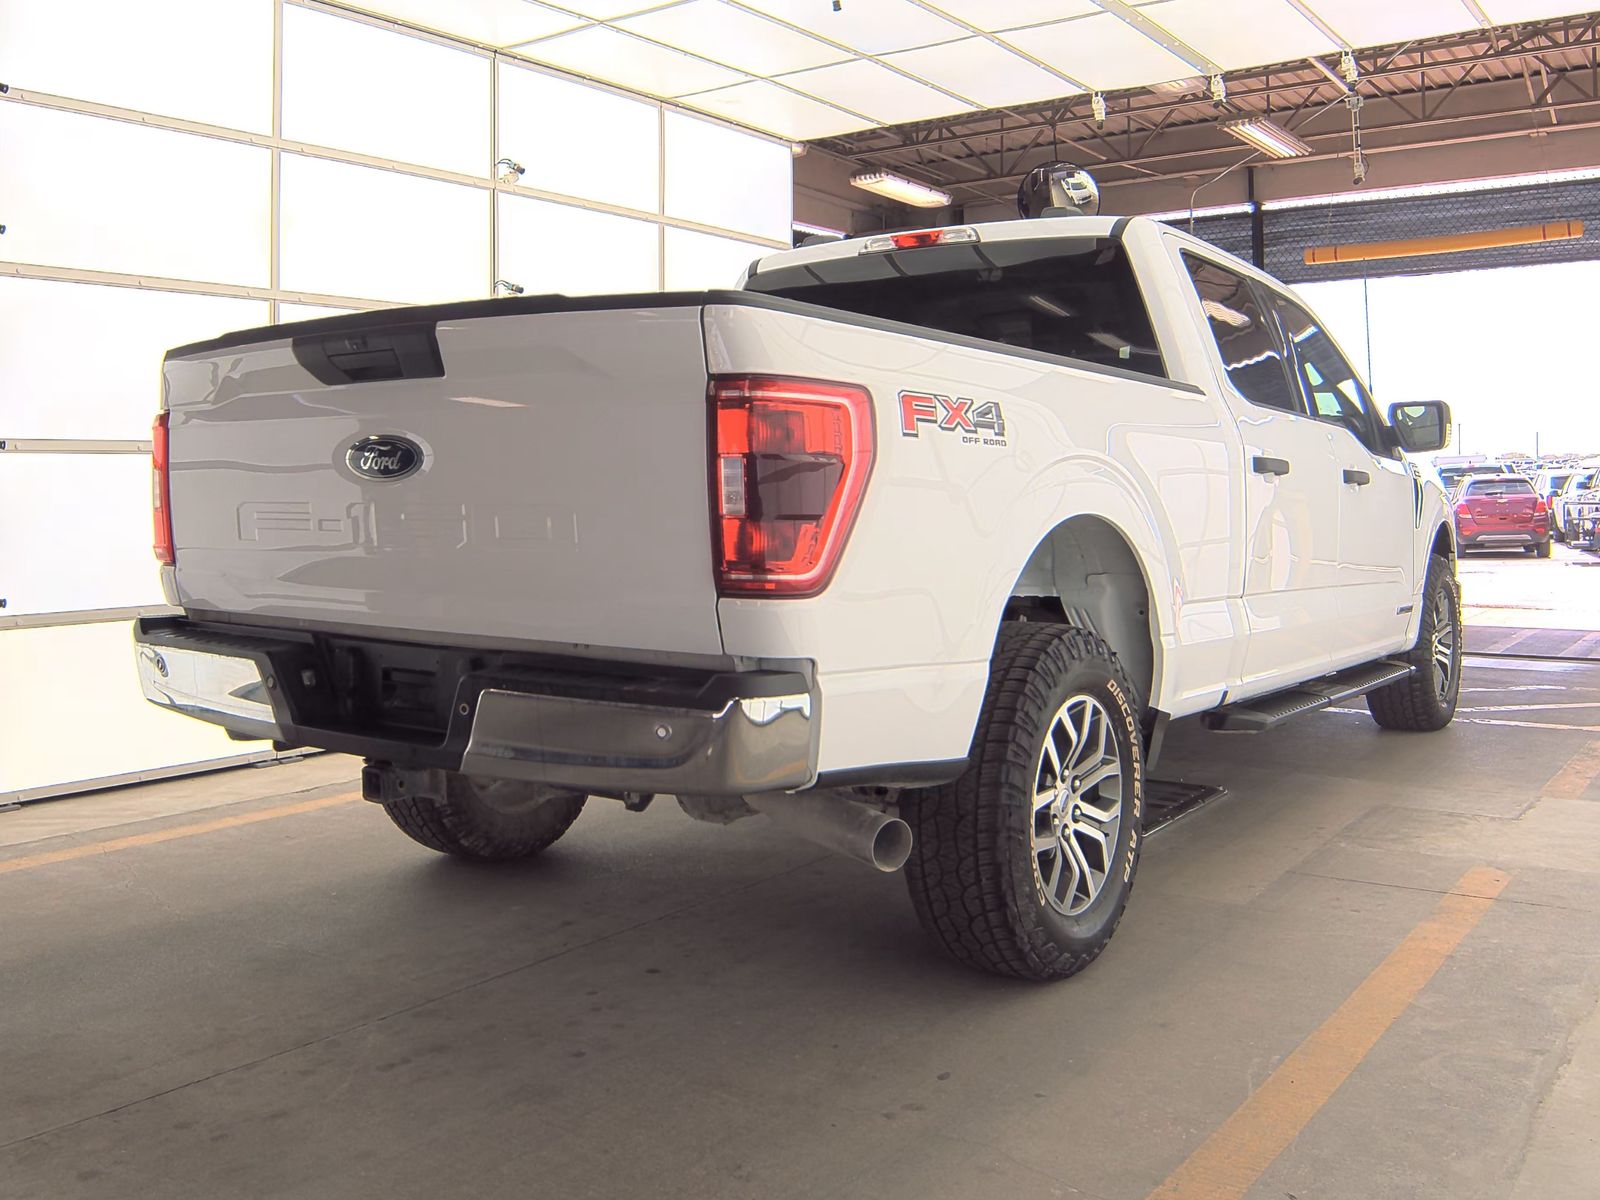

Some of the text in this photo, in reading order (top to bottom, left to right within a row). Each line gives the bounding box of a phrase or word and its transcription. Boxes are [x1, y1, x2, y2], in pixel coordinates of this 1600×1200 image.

[898, 389, 1006, 438] FX4
[360, 444, 403, 470] Ford
[962, 436, 1008, 448] OFF ROAD
[1105, 678, 1142, 819] DISCOVERER
